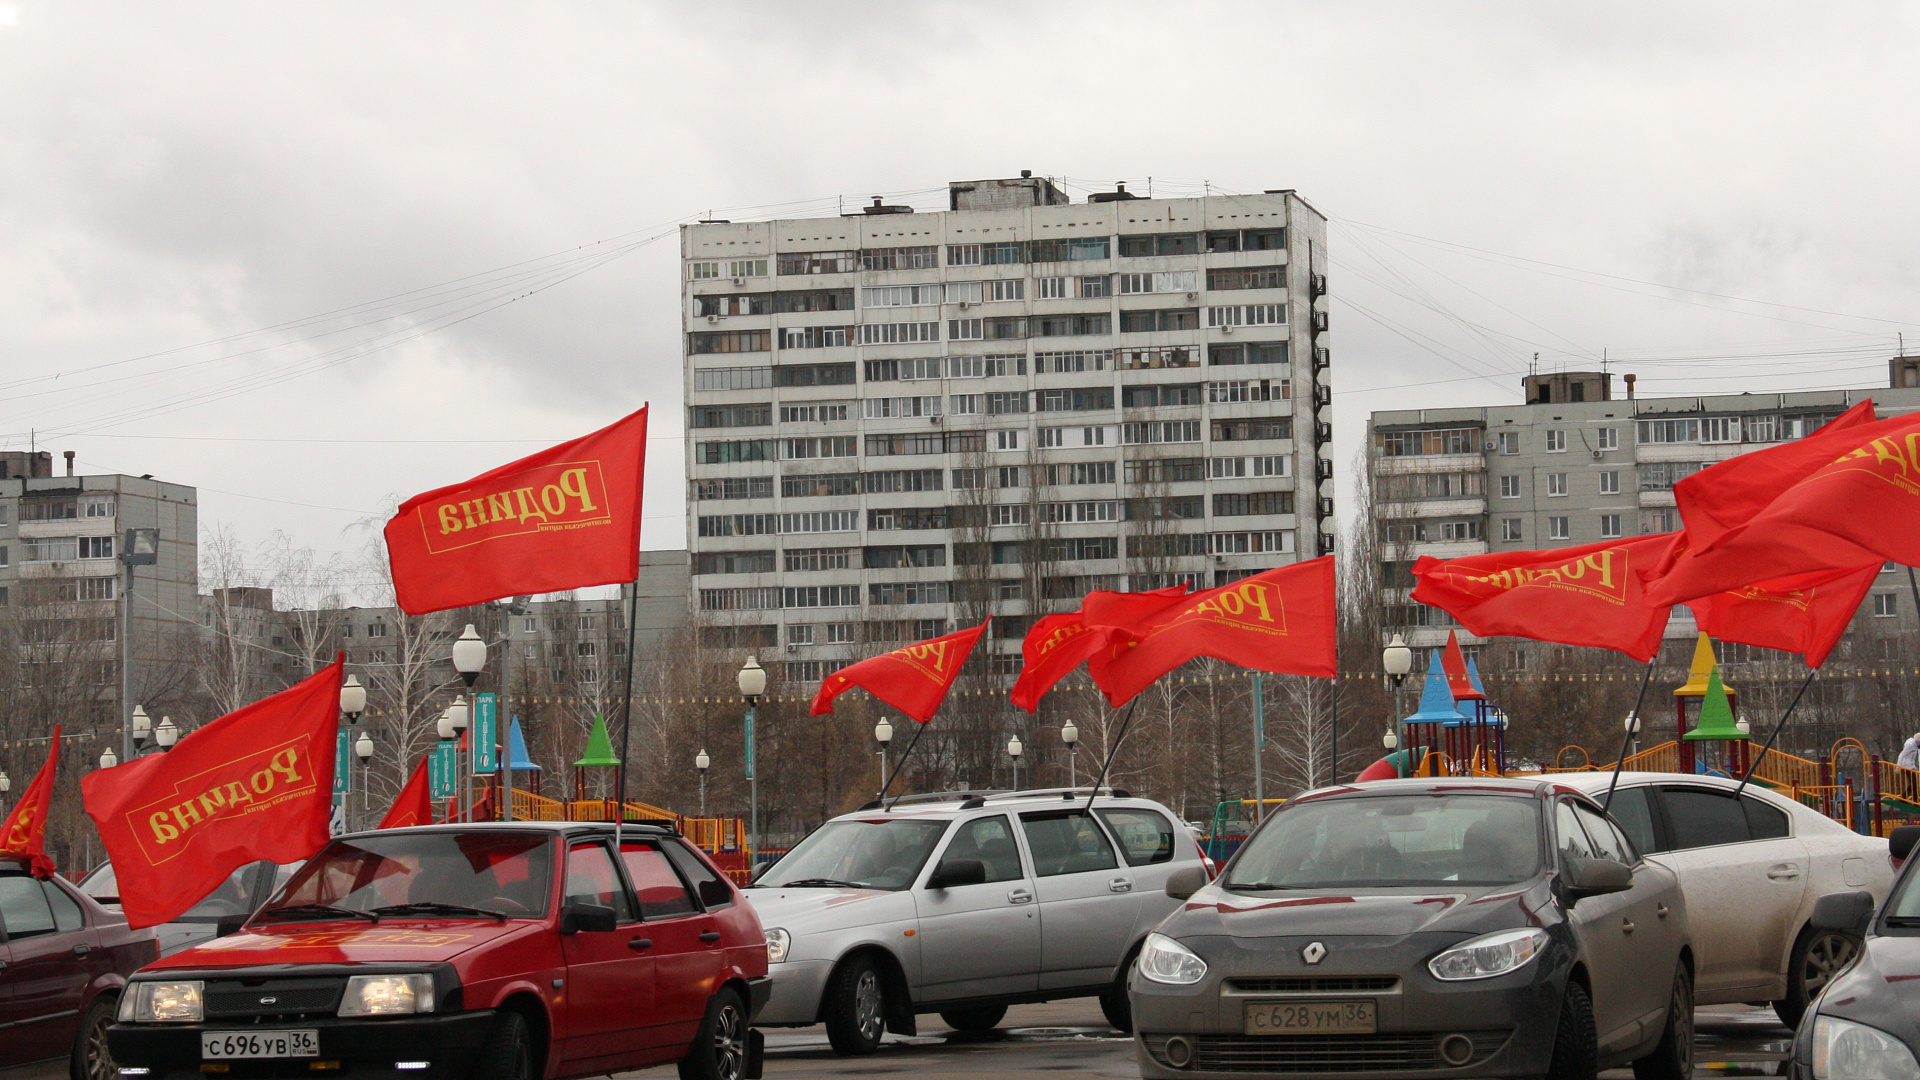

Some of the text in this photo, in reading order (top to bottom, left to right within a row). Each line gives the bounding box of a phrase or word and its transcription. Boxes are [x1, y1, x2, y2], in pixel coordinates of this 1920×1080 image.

[476, 696, 493, 704] ПАРК
[1345, 1004, 1367, 1020] 36
[292, 1033, 311, 1048] 36
